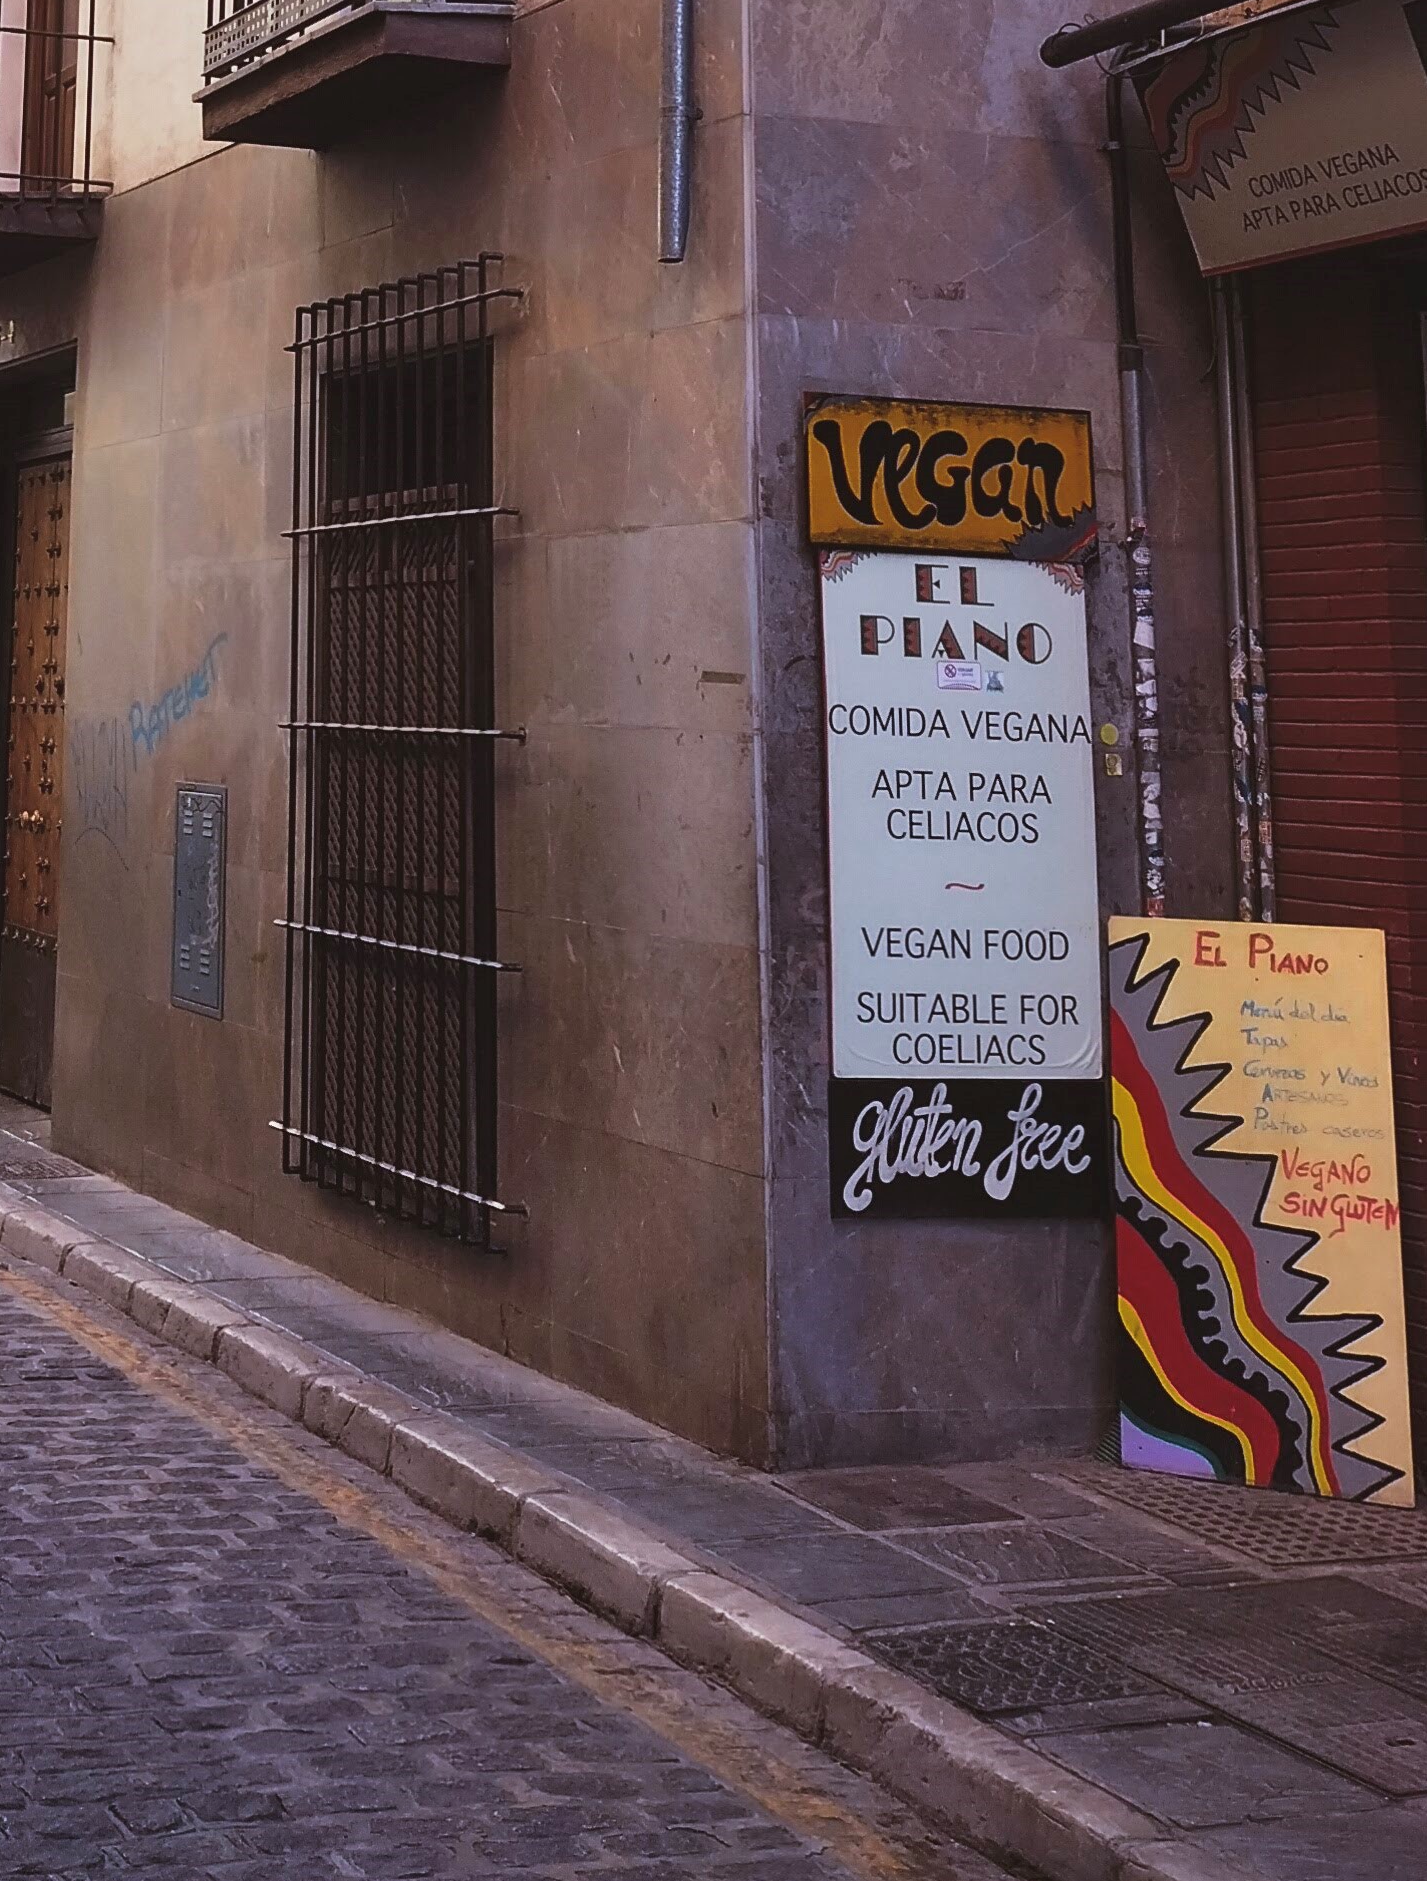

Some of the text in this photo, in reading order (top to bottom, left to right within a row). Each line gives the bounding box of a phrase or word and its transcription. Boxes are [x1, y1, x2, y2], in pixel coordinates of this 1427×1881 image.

[1249, 143, 1400, 197] COMIDA VEGANA
[1243, 205, 1290, 232] APTA
[1289, 193, 1342, 220] PARA
[914, 563, 995, 607] EL
[860, 614, 1053, 665] PIANO
[828, 704, 1092, 744] COMIDA VEGANA
[871, 769, 1052, 804] APTA PARA
[887, 808, 1039, 844] CELIACOS
[861, 926, 1069, 961] VEGAN FOOD
[856, 991, 1079, 1025] SUITABLE FOR
[892, 1033, 1046, 1065] COELIACS
[843, 1082, 1091, 1211] gluten free
